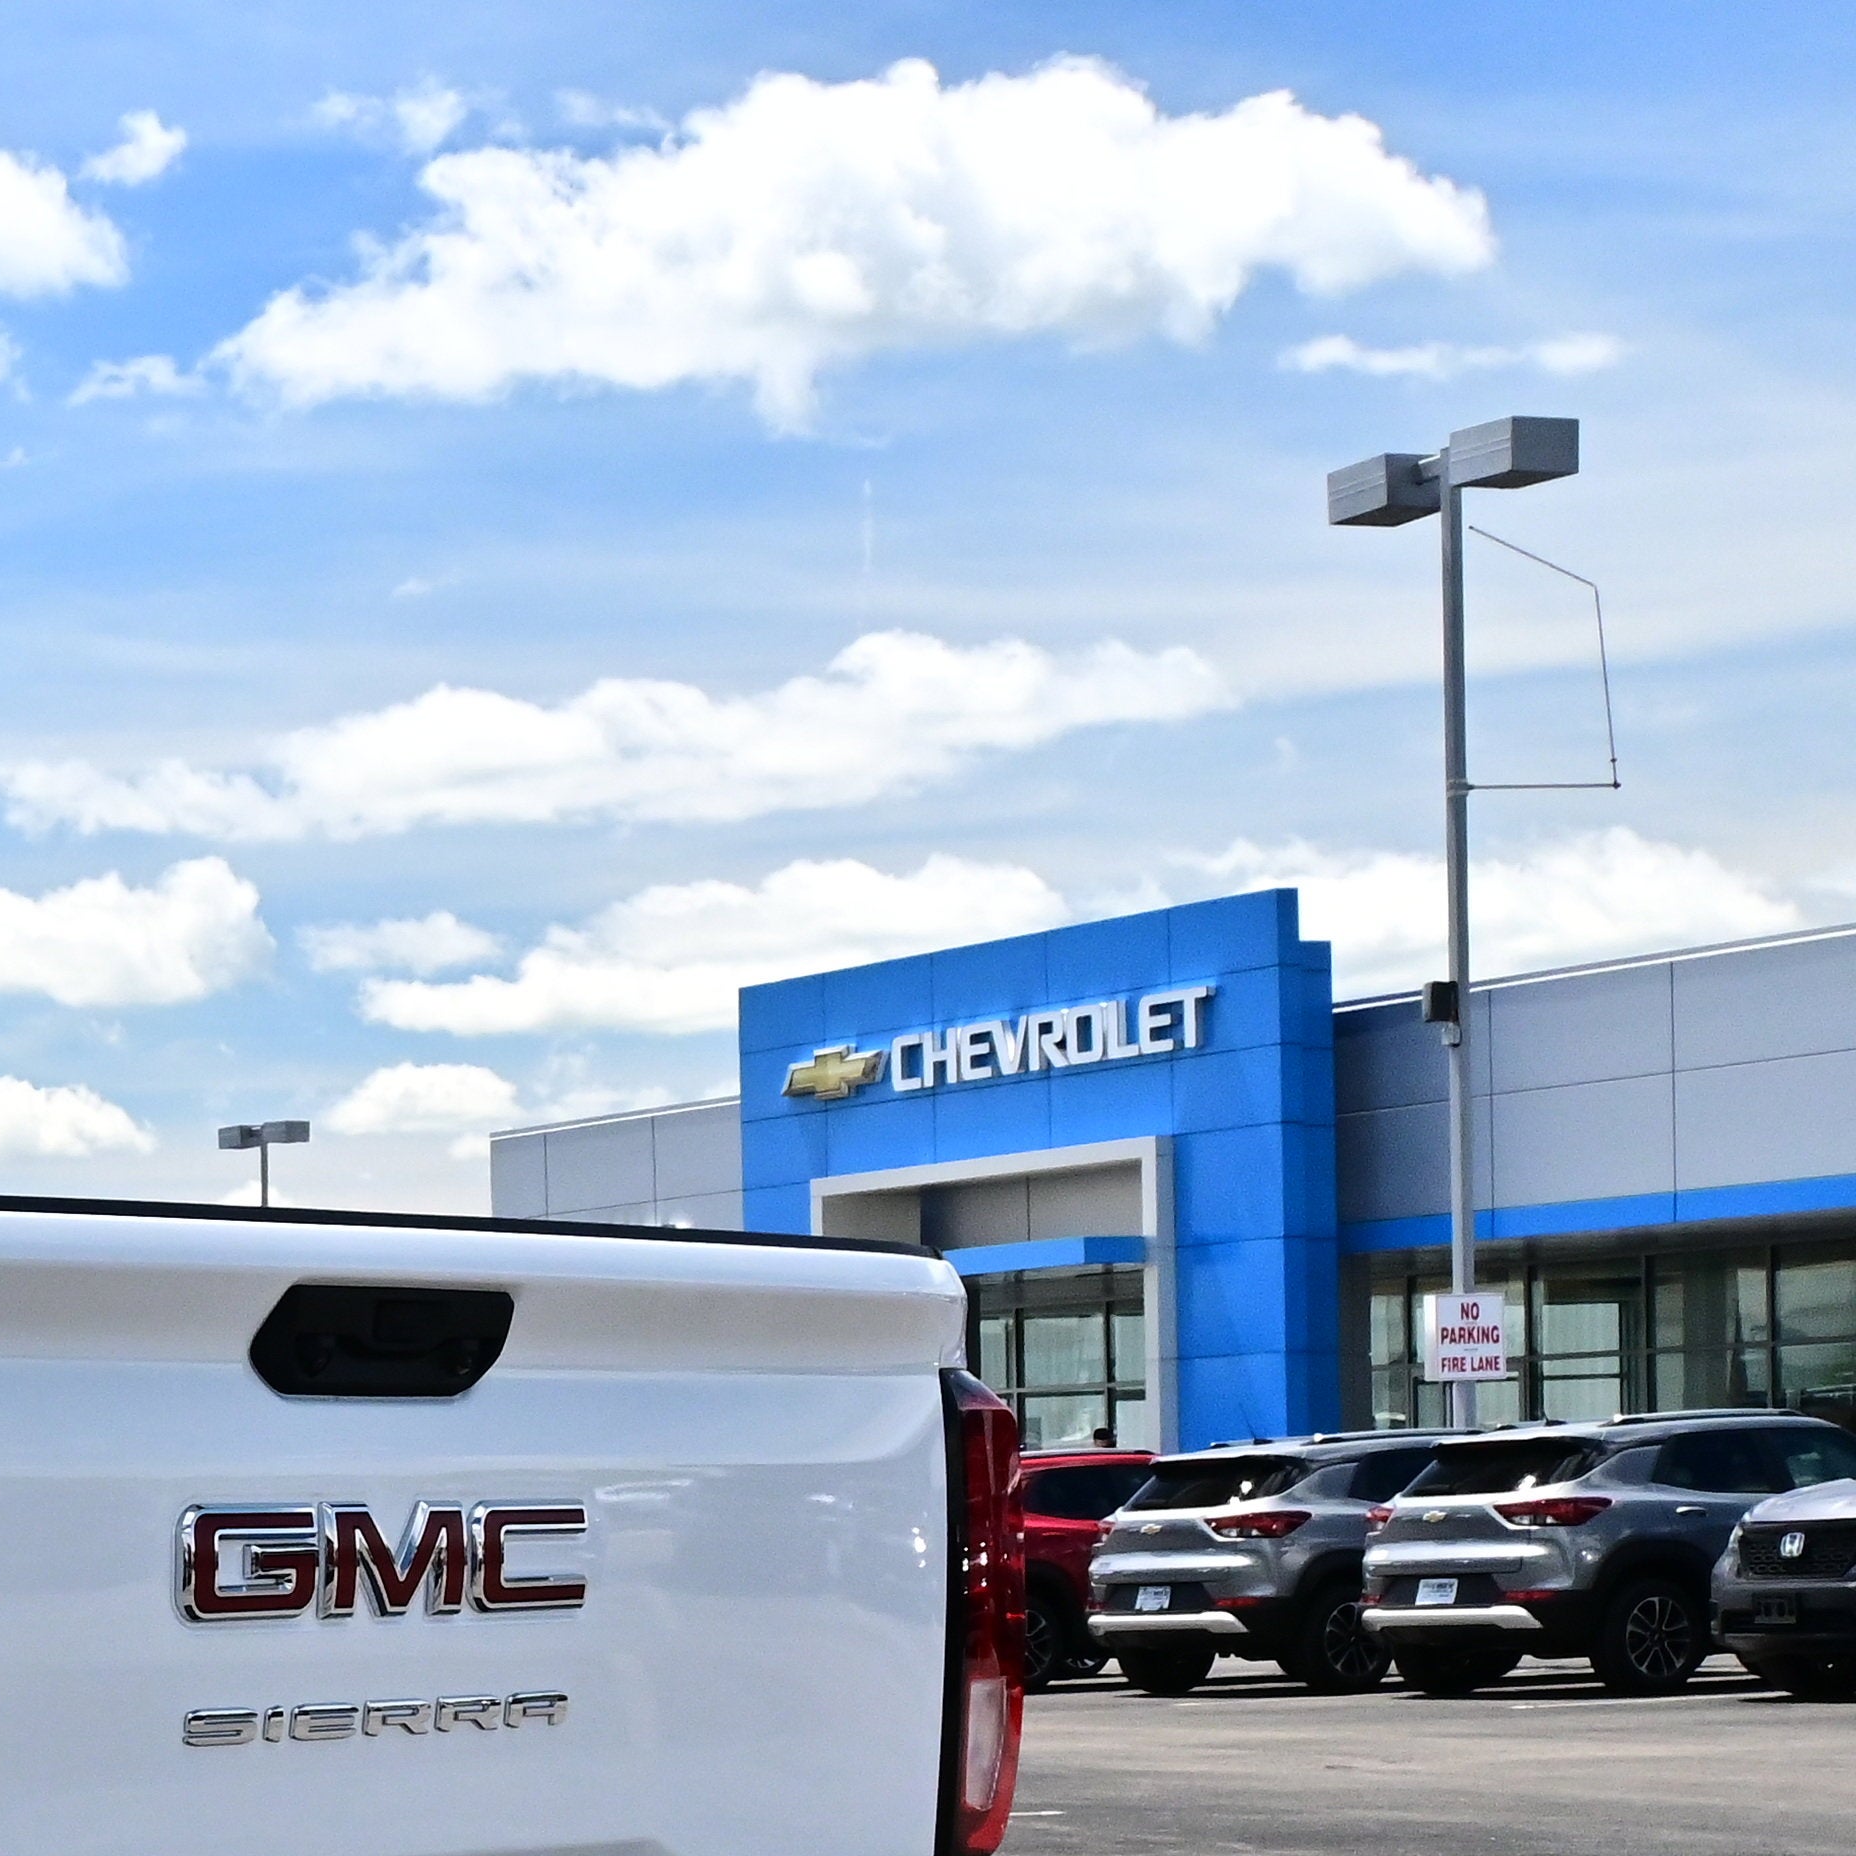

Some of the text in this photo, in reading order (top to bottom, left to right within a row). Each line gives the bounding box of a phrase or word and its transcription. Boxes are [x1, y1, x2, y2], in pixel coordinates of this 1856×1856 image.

[891, 986, 1215, 1092] CHEVROLET
[1460, 1302, 1480, 1321] NO
[1440, 1325, 1500, 1345] PARKING
[1441, 1355, 1501, 1373] FIRE LANE
[174, 1499, 588, 1622] GMC
[183, 1690, 570, 1748] SIERRA
